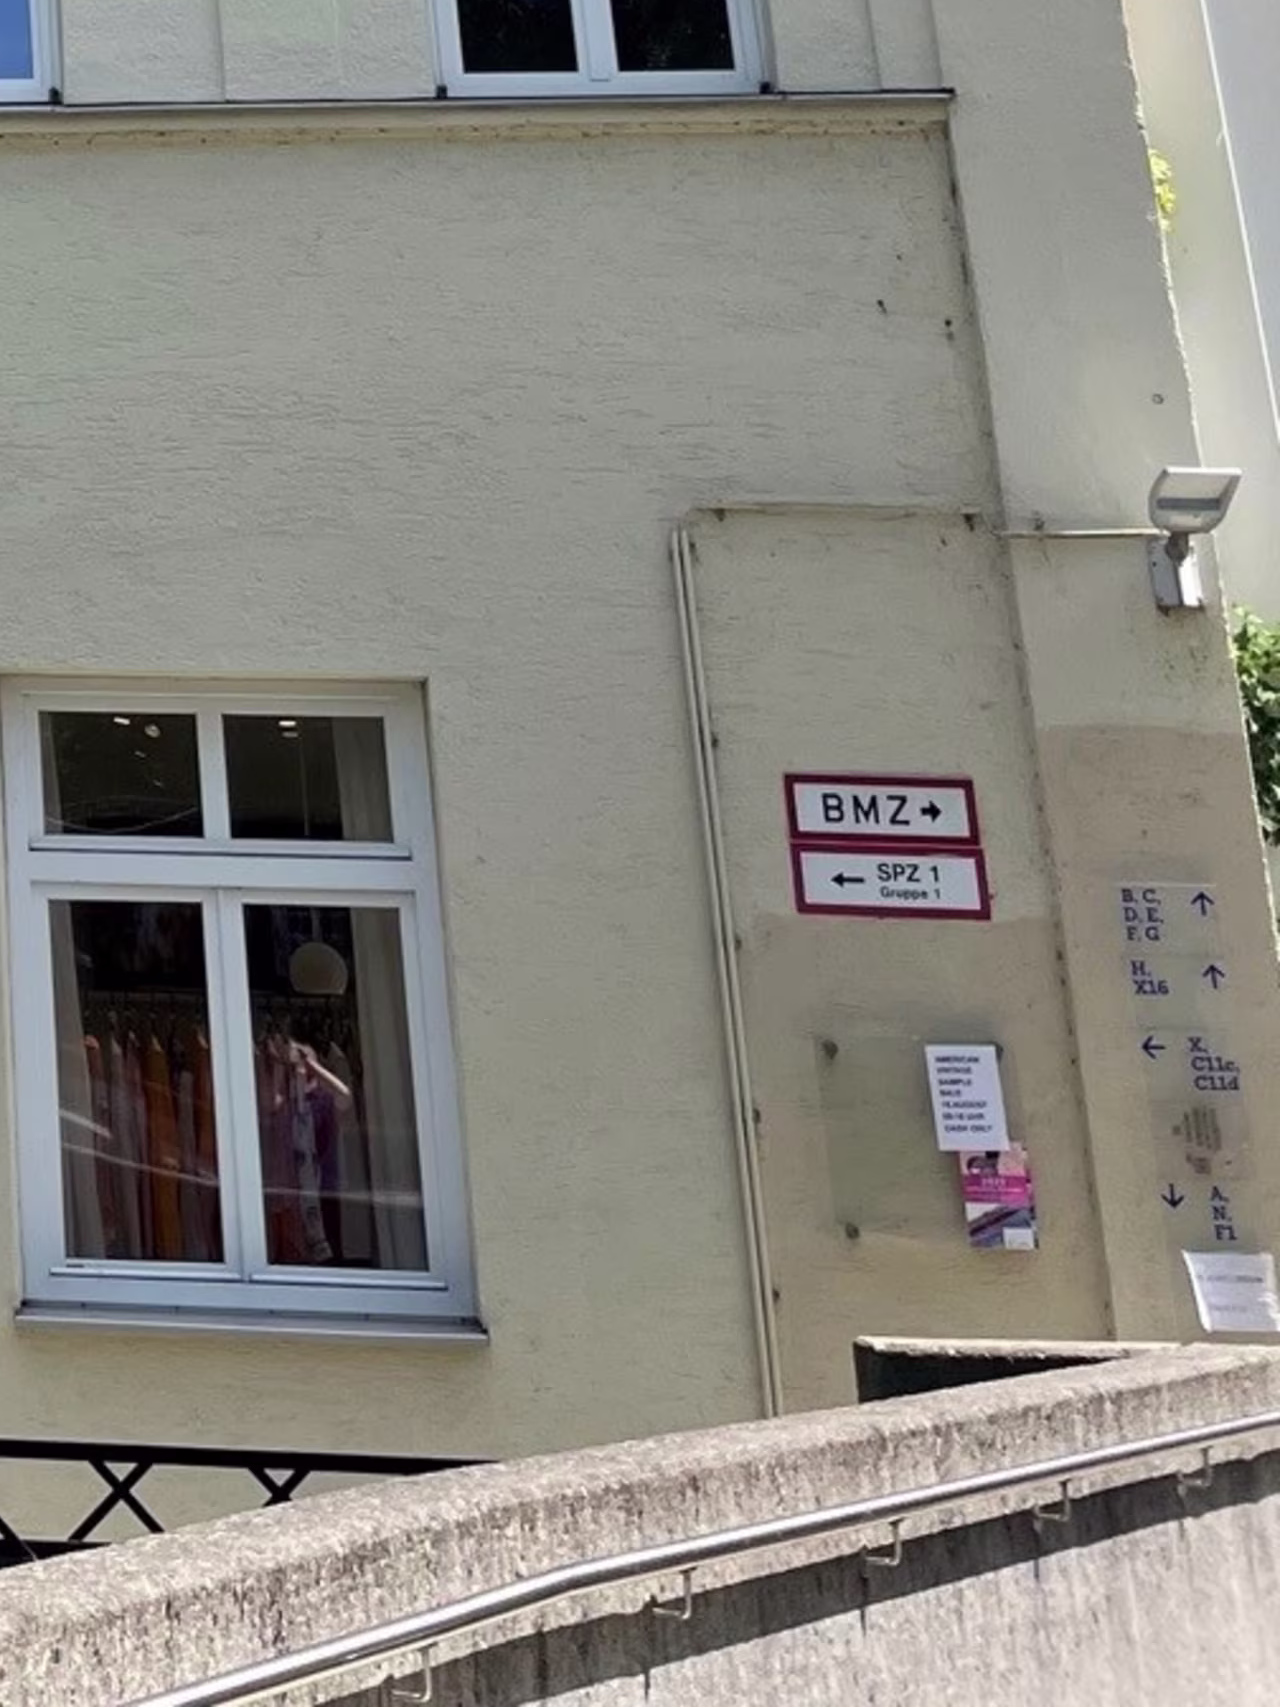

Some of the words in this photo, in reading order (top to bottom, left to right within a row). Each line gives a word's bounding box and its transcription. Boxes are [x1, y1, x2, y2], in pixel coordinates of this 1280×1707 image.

[821, 793, 910, 826] BMZ
[876, 863, 921, 882] SPZ
[930, 865, 939, 882] 1
[880, 886, 928, 900] Gruppe
[934, 889, 941, 899] 1
[1145, 926, 1160, 941] G
[1133, 979, 1169, 995] X16
